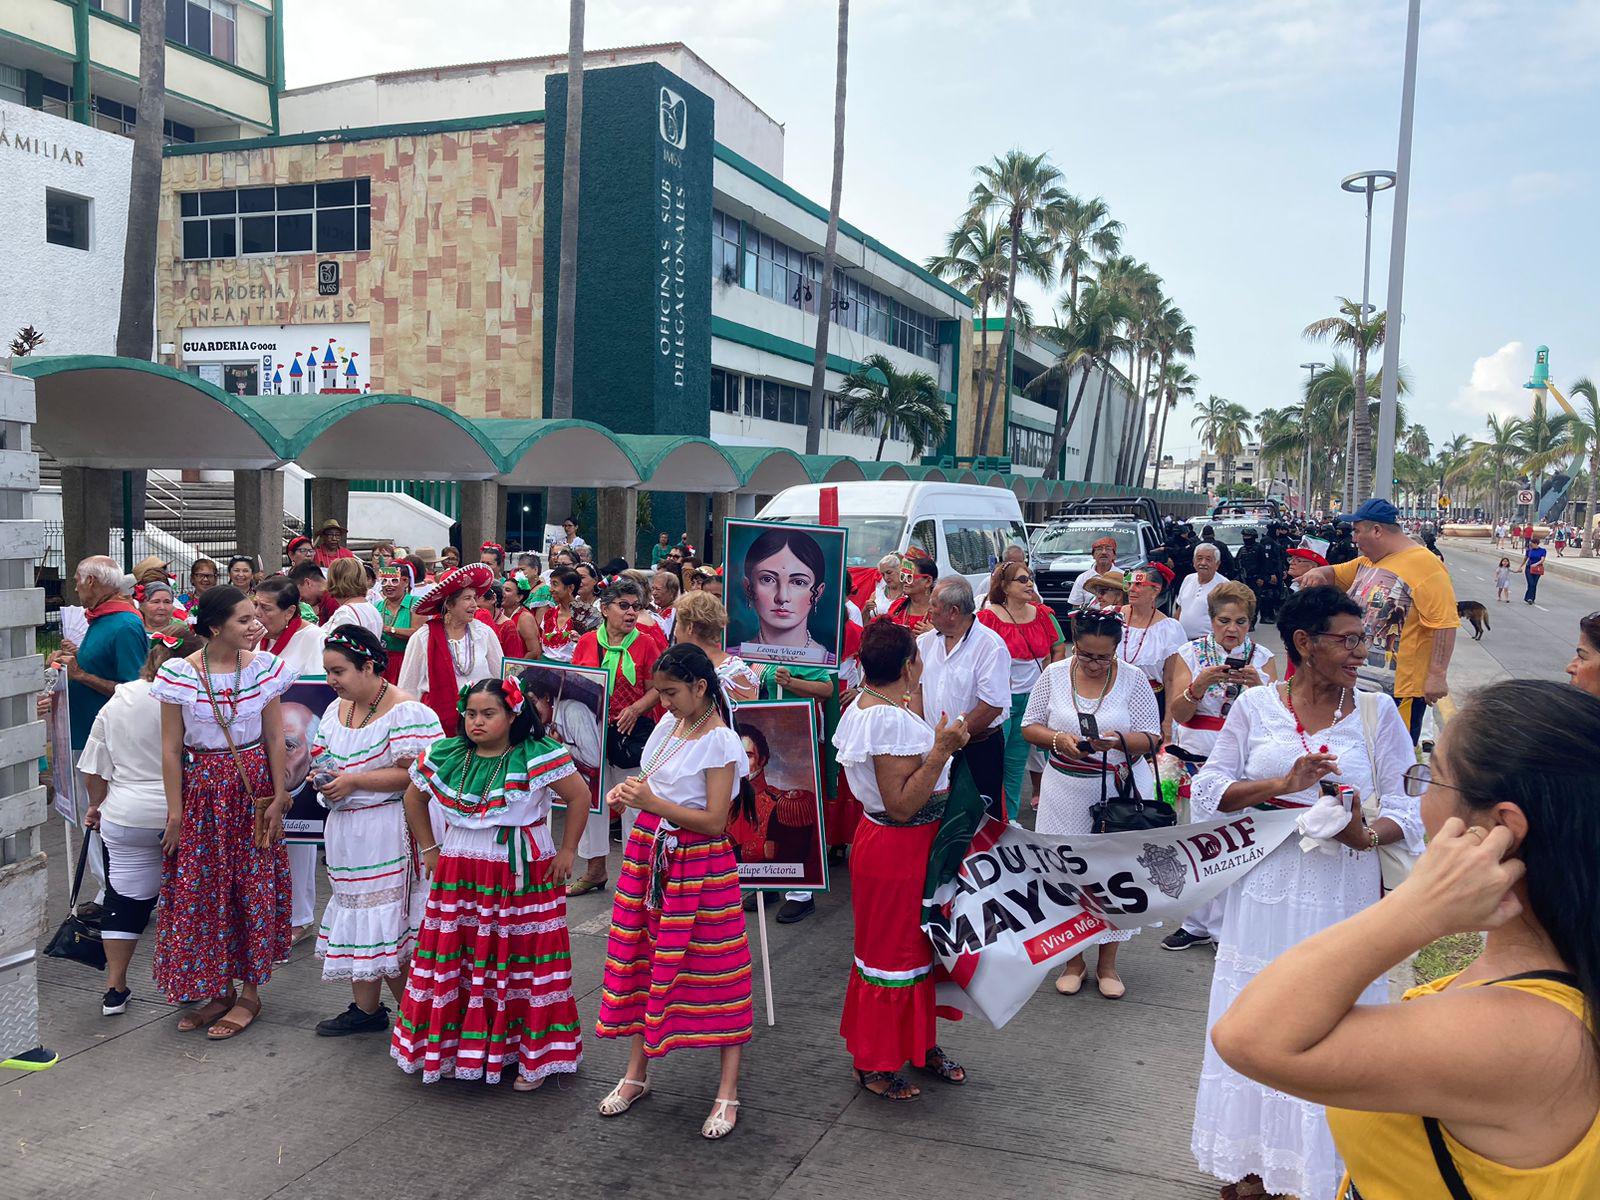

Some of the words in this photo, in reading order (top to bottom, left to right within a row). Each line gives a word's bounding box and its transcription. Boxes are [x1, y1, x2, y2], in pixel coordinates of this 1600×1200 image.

[0, 128, 84, 167] AMILIAR
[661, 178, 671, 223] SUB
[320, 284, 337, 293] IMSS
[660, 239, 671, 356] OFICINAS
[675, 186, 685, 387] DELEGACIONALES
[190, 305, 285, 321] INFANTIL
[303, 303, 355, 320] IMSS
[183, 341, 249, 352] GUARDERIA
[756, 646, 779, 654] Leona
[780, 648, 806, 656] Vicario
[1187, 816, 1256, 862] DIF
[762, 865, 797, 875] Victoria
[951, 844, 1088, 899] ADULTOS
[1203, 847, 1264, 877] MAZATLÁN
[930, 871, 1149, 957] MAYORES
[1041, 929, 1075, 955] ¡Viva
